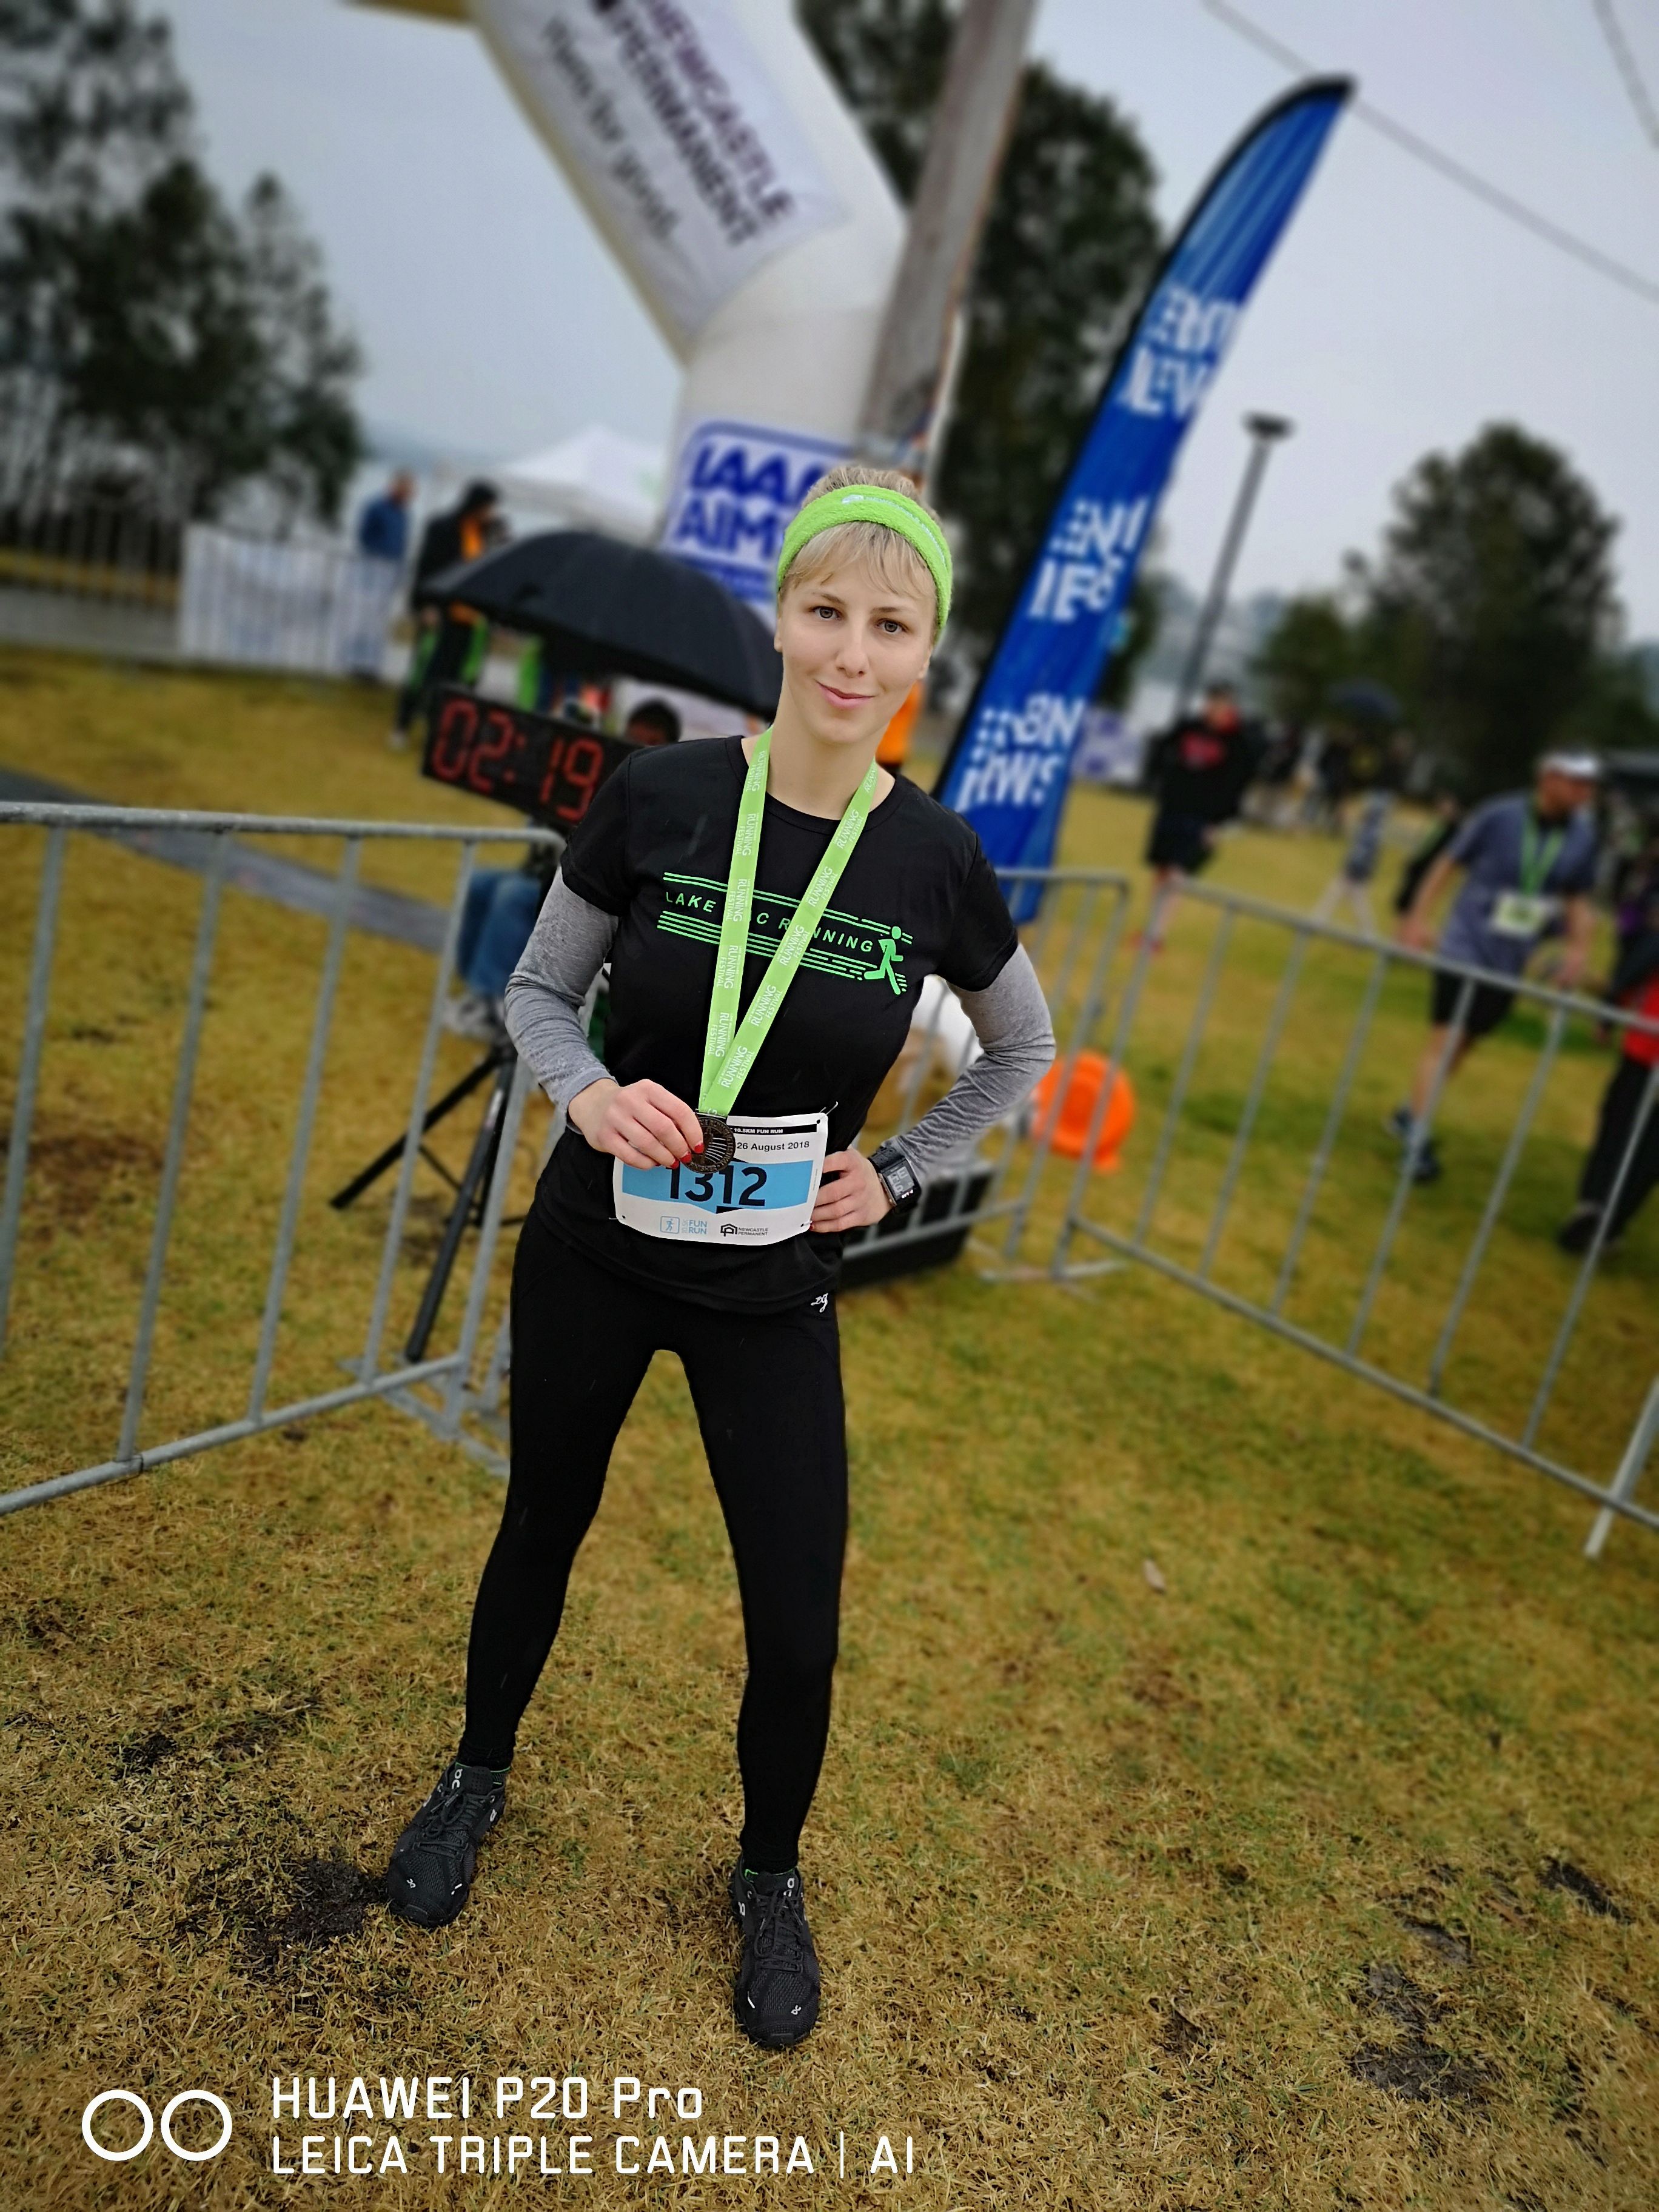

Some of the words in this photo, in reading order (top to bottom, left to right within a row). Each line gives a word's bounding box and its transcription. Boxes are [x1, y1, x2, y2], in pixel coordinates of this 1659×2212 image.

[432, 699, 605, 823] 02:19
[742, 814, 756, 856] RUNNING
[837, 809, 859, 849] RUNNING
[733, 879, 747, 922] RUNNING
[808, 866, 833, 907] RUNNING
[666, 891, 717, 913] LAKE
[778, 917, 873, 952] RNNING
[724, 945, 739, 988] RUNNING
[779, 925, 805, 966] RUNNING
[751, 985, 776, 1027] RUNNING
[765, 990, 783, 1019] FESTIVAL
[708, 1024, 718, 1054] FESTIVAL
[716, 1012, 729, 1057] RUNNING
[721, 1046, 748, 1088] RUNNING
[736, 1051, 755, 1079] FESTIVAL
[751, 1143, 785, 1152] August
[788, 1141, 809, 1150] 2018
[666, 1161, 767, 1207] 1312
[689, 1219, 708, 1228] FUN
